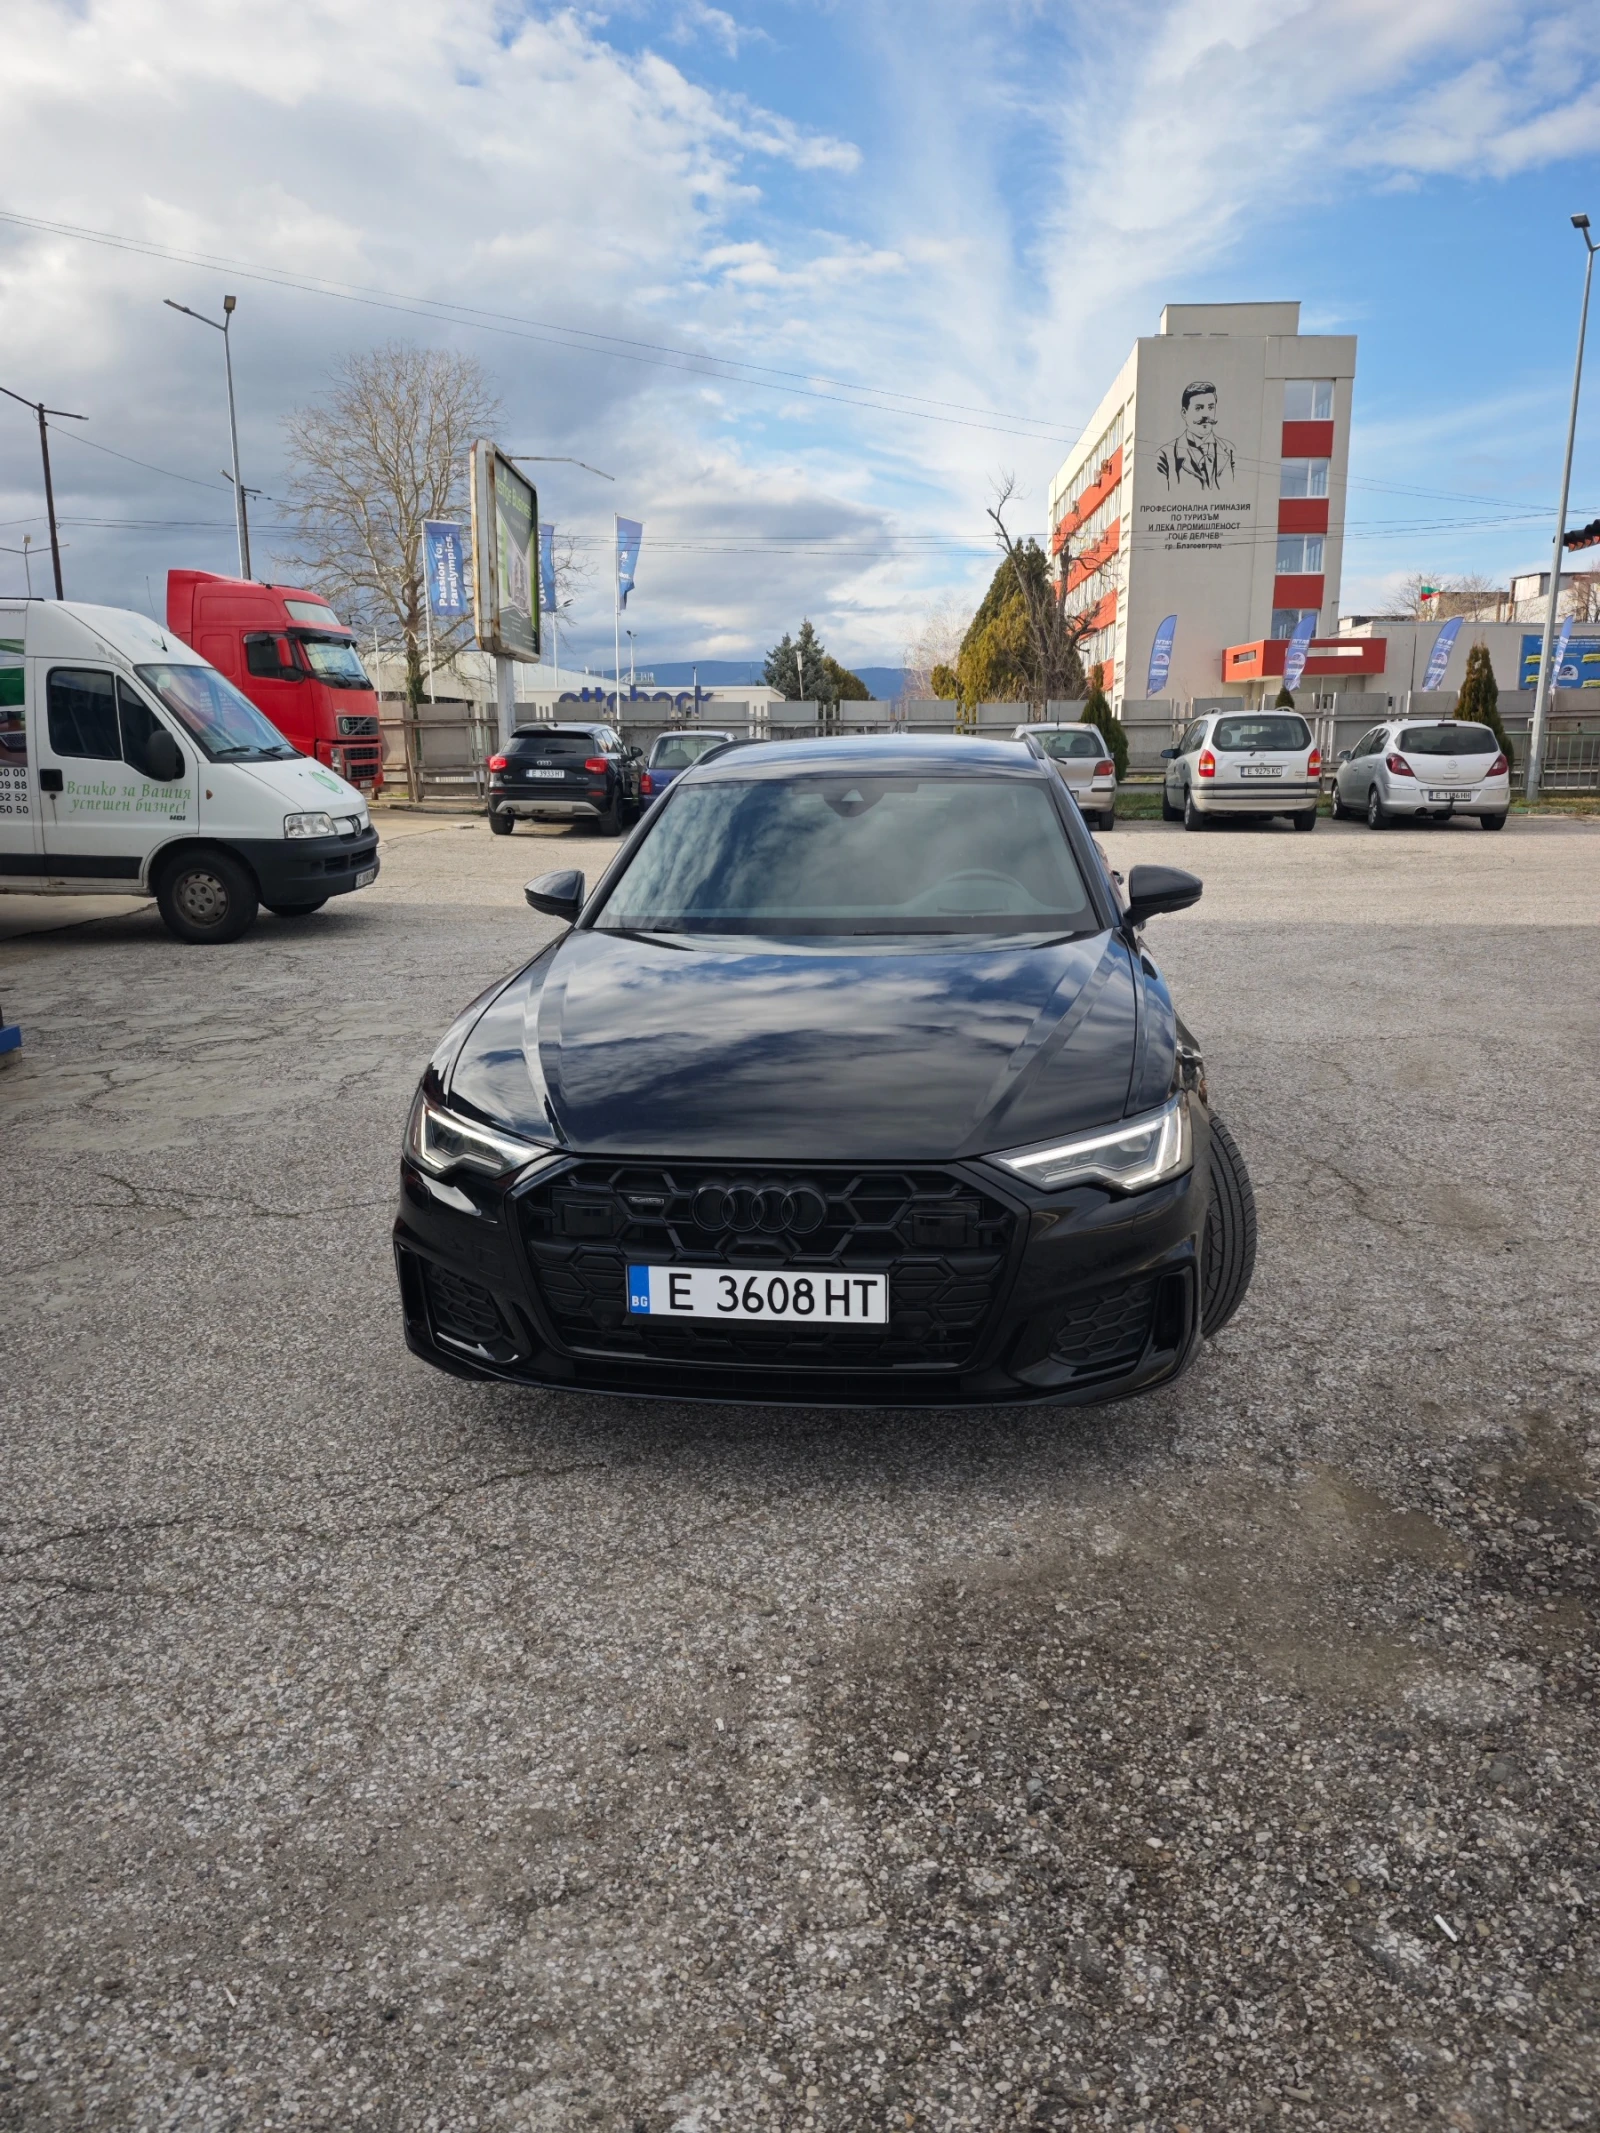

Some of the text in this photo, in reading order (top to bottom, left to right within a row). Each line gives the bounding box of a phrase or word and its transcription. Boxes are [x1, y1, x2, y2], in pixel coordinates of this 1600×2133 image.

[1140, 503, 1251, 512] ПРОФЕСИОНАЛНА ГИМНАЗИЯ
[1184, 513, 1220, 521] ТУРИЗЪМ
[1176, 522, 1240, 531] ПРОМИШЛЕНОСТ
[434, 542, 448, 607] Passion for
[445, 533, 459, 607] Paralympics.
[13, 768, 26, 778] 00
[14, 780, 27, 790] 88
[66, 780, 192, 800] Всичко за Вашия
[0, 792, 28, 802] 52 52
[0, 804, 29, 814] 50 50
[68, 798, 186, 814] успешен бизнес!
[668, 1273, 694, 1310] E
[631, 1295, 648, 1307] BG
